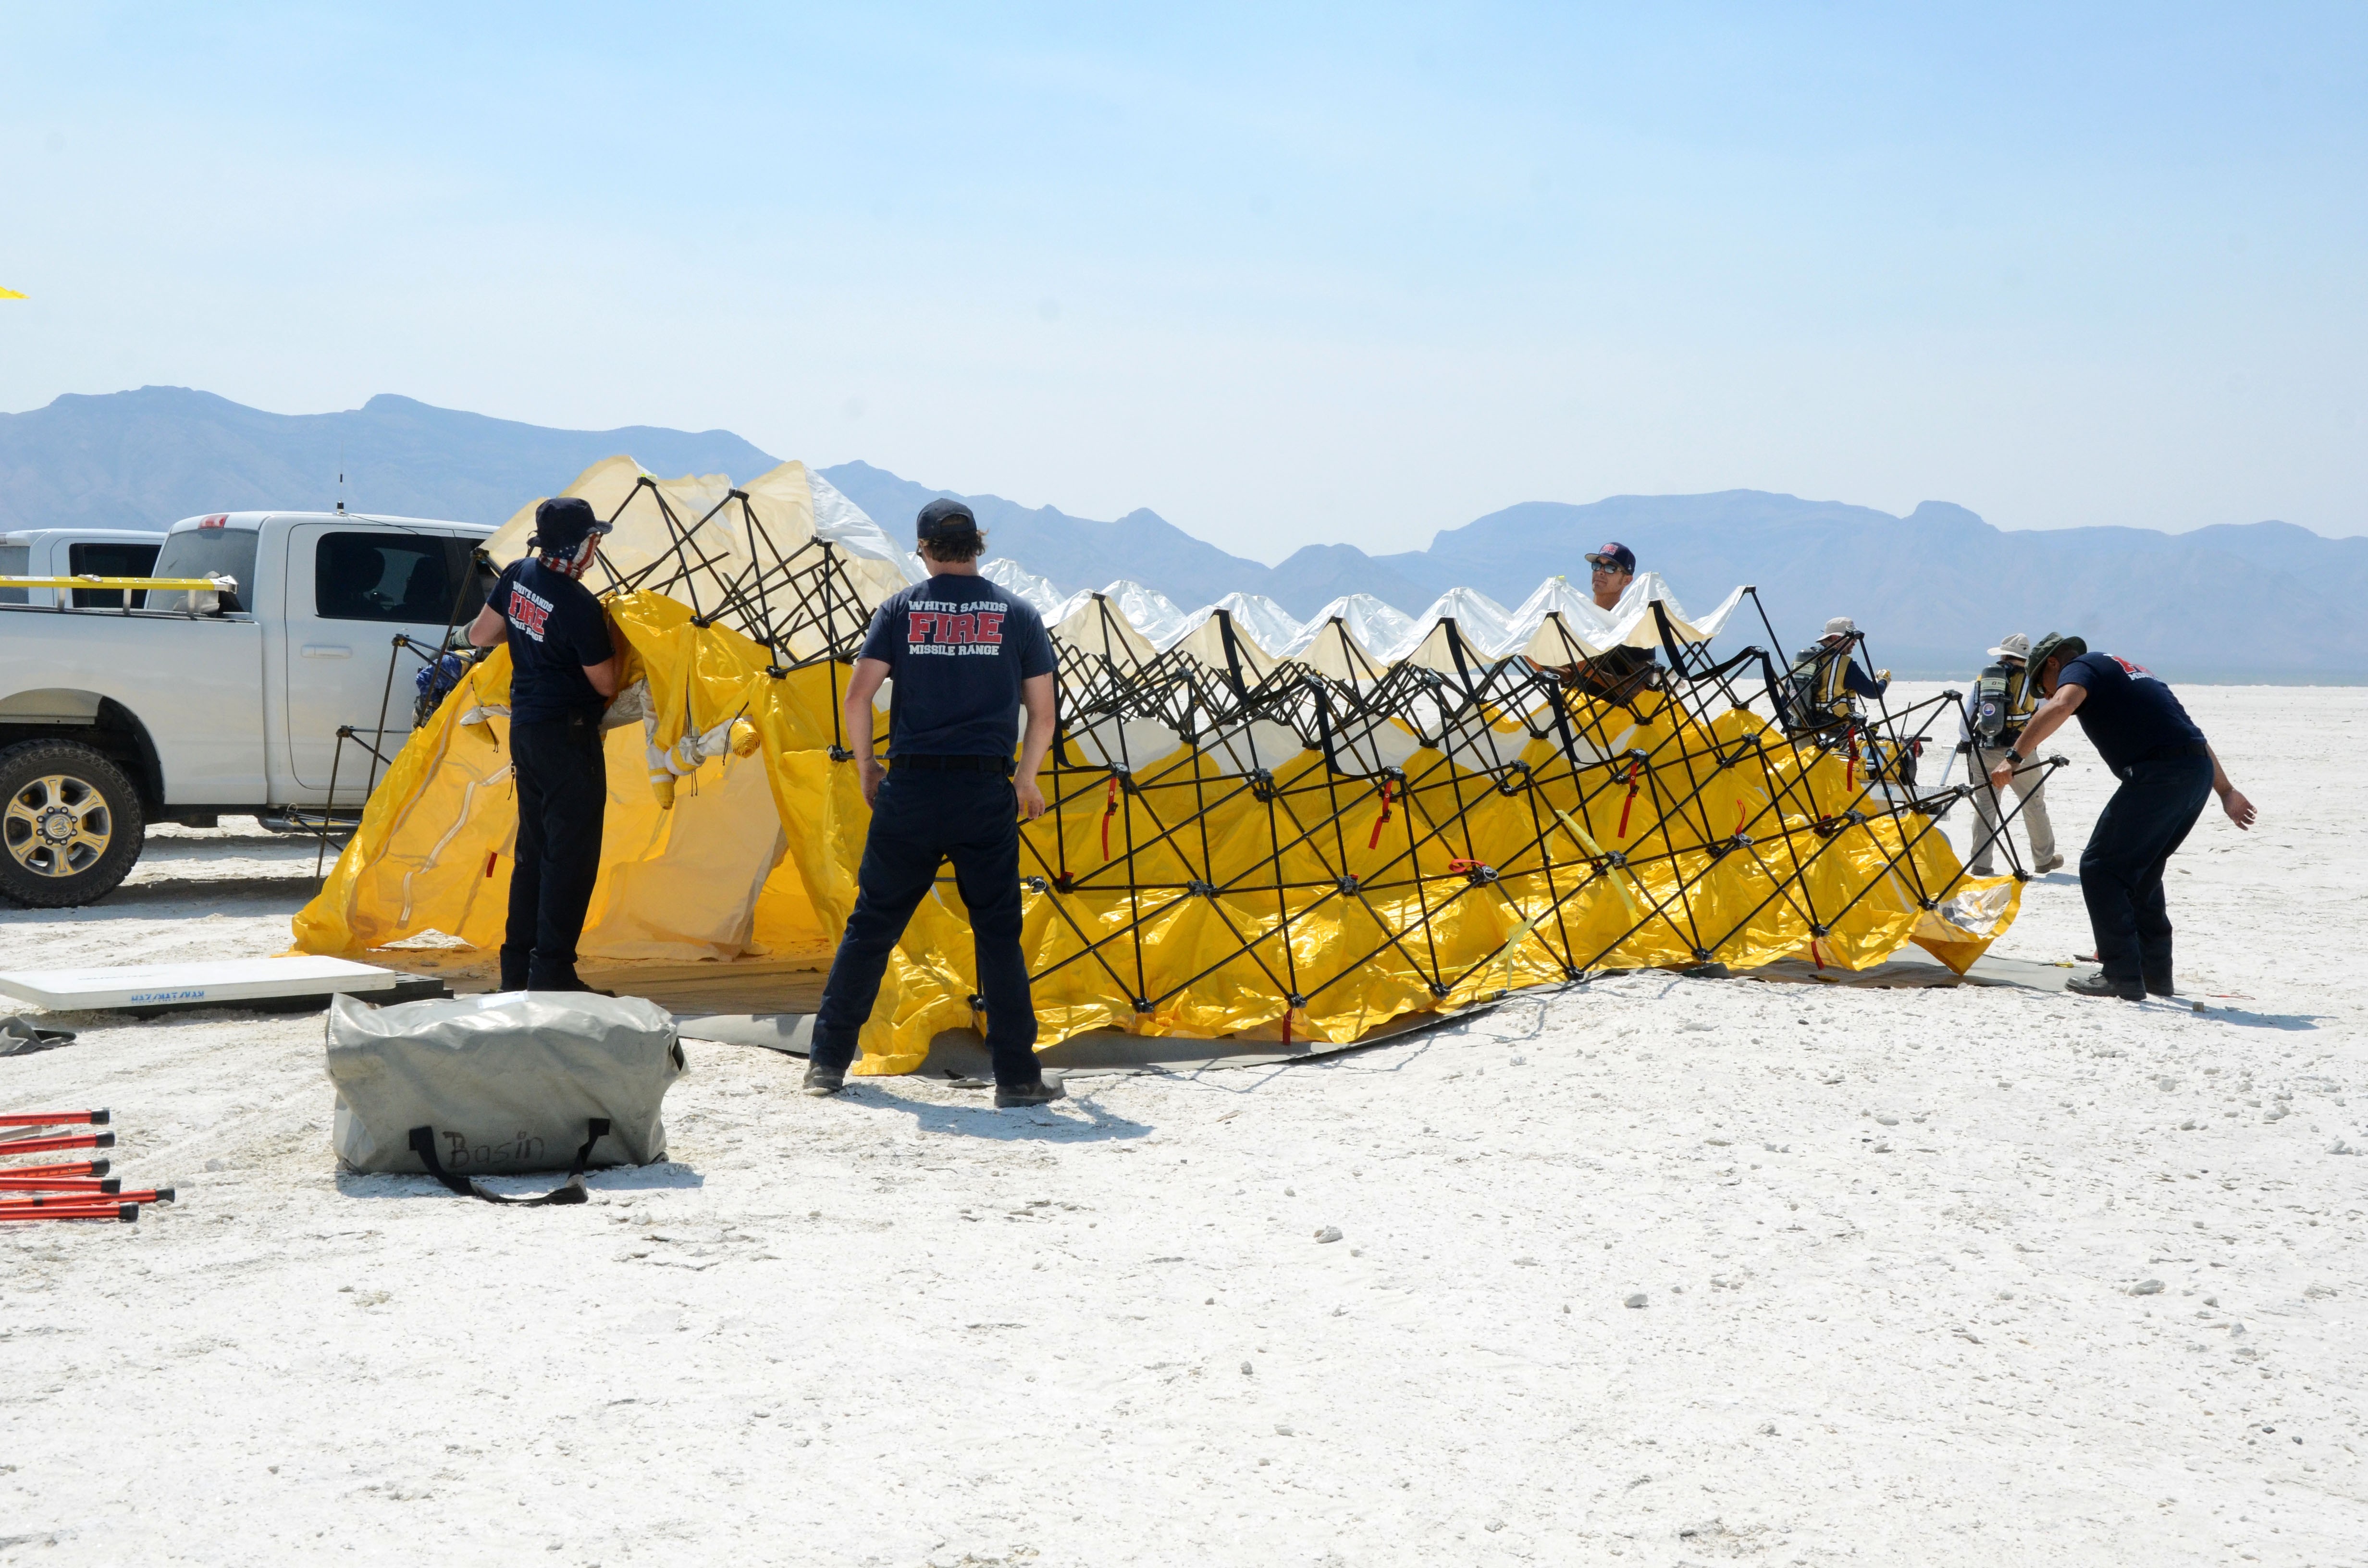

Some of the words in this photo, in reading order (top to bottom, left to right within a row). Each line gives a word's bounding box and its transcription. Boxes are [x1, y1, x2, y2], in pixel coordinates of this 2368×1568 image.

[508, 590, 548, 635] FIRE
[531, 593, 554, 612] SANDS
[908, 600, 957, 612] WHITE
[960, 601, 1008, 612] SANDS
[908, 612, 1004, 644] FIRE
[909, 645, 955, 656] MISSILE
[958, 645, 999, 656] RANGE
[443, 1130, 544, 1168] Basin
